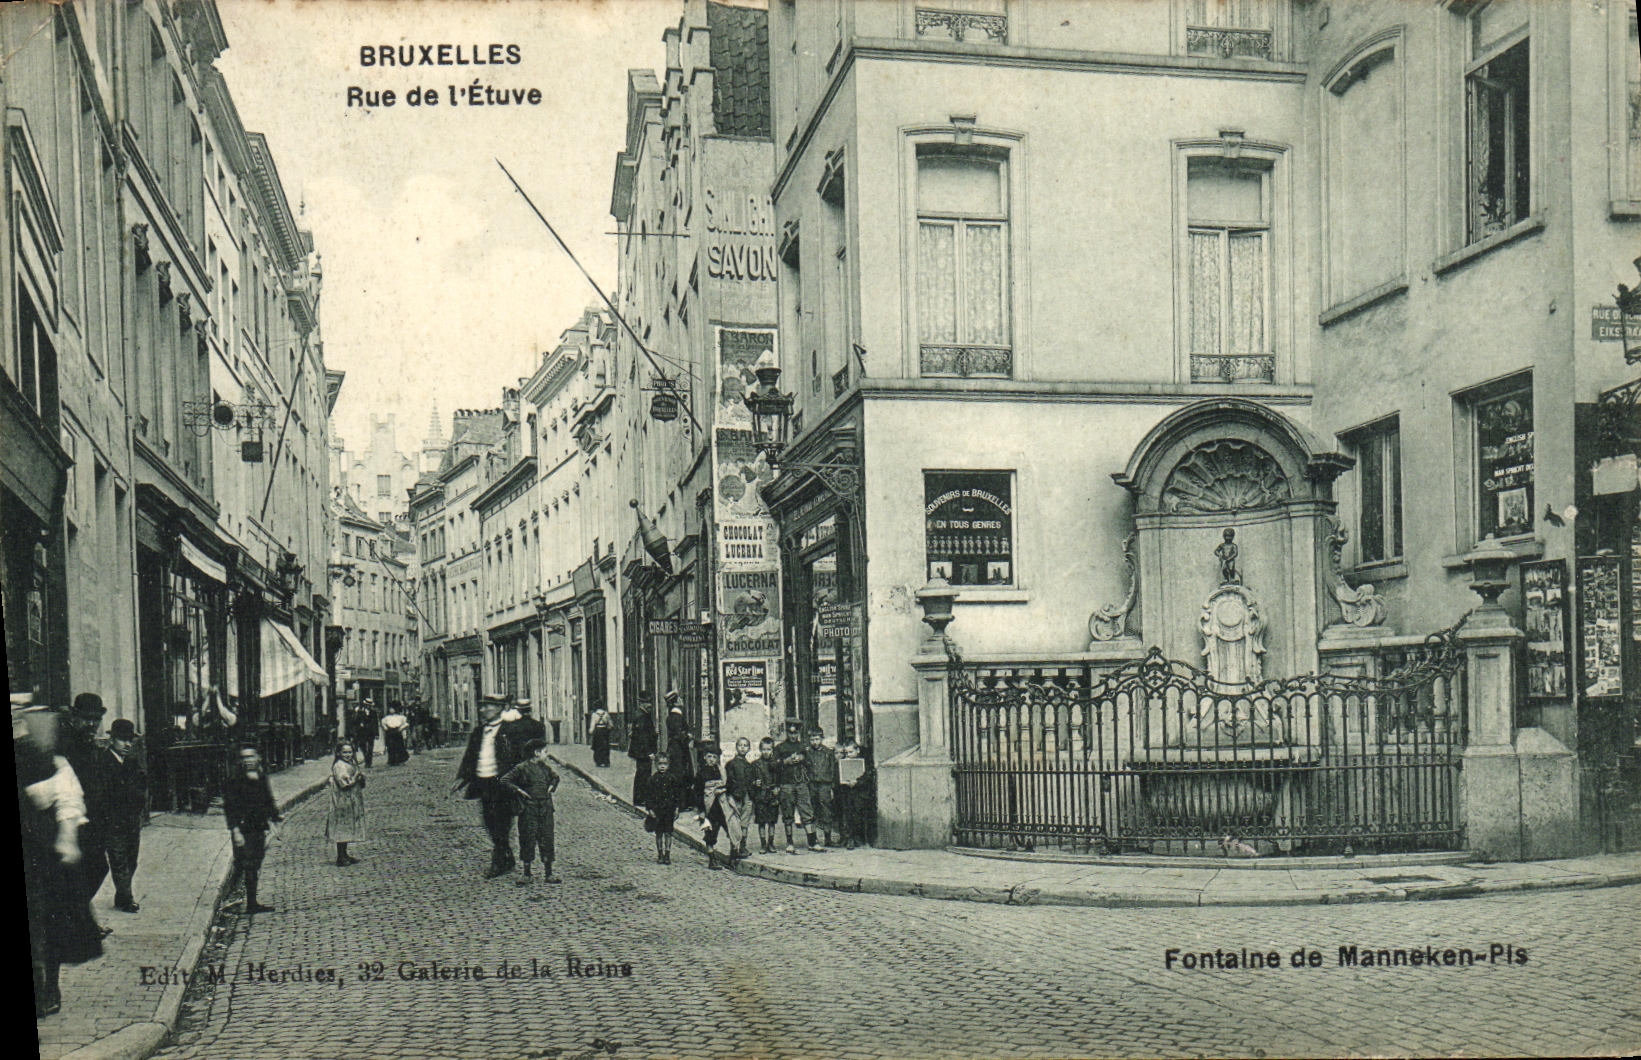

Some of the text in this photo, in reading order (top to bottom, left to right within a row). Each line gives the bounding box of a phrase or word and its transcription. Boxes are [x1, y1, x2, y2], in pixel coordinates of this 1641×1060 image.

[707, 244, 777, 281] SAVON
[1593, 308, 1611, 320] RUE
[926, 490, 960, 515] SOUVENIRS
[971, 488, 1012, 515] BRUXELLES
[936, 520, 1001, 529] EN TOUS GENRES
[723, 525, 763, 540] CHOCOLAT
[725, 544, 763, 558] LUCERNA
[725, 573, 777, 588] LUCERNA
[649, 620, 678, 634] CIGARES
[727, 640, 780, 651] CHOCOLAT
[725, 664, 764, 677] Red Star Line
